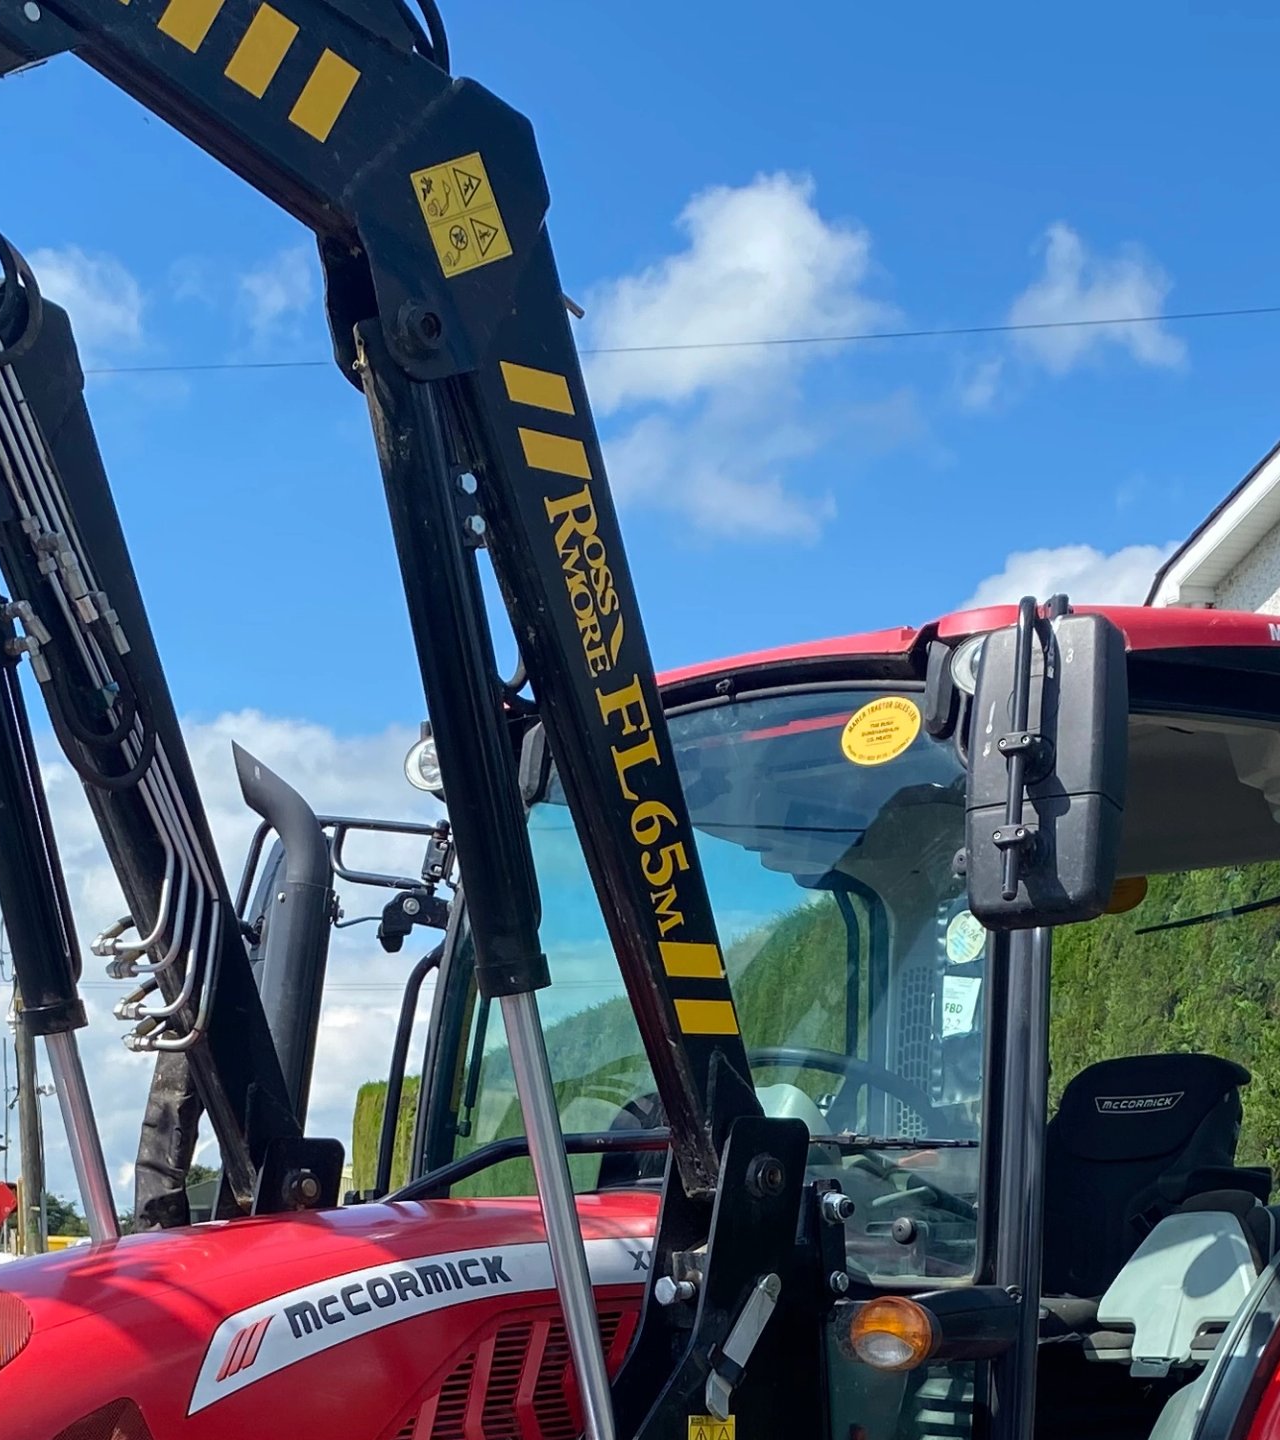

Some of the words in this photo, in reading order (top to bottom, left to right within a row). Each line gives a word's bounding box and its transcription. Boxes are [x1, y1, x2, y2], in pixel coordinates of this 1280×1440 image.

[944, 1002, 964, 1014] FBD
[1101, 1097, 1174, 1110] McCORMICK
[626, 1250, 653, 1271] X
[283, 1255, 513, 1340] McCORMICK
